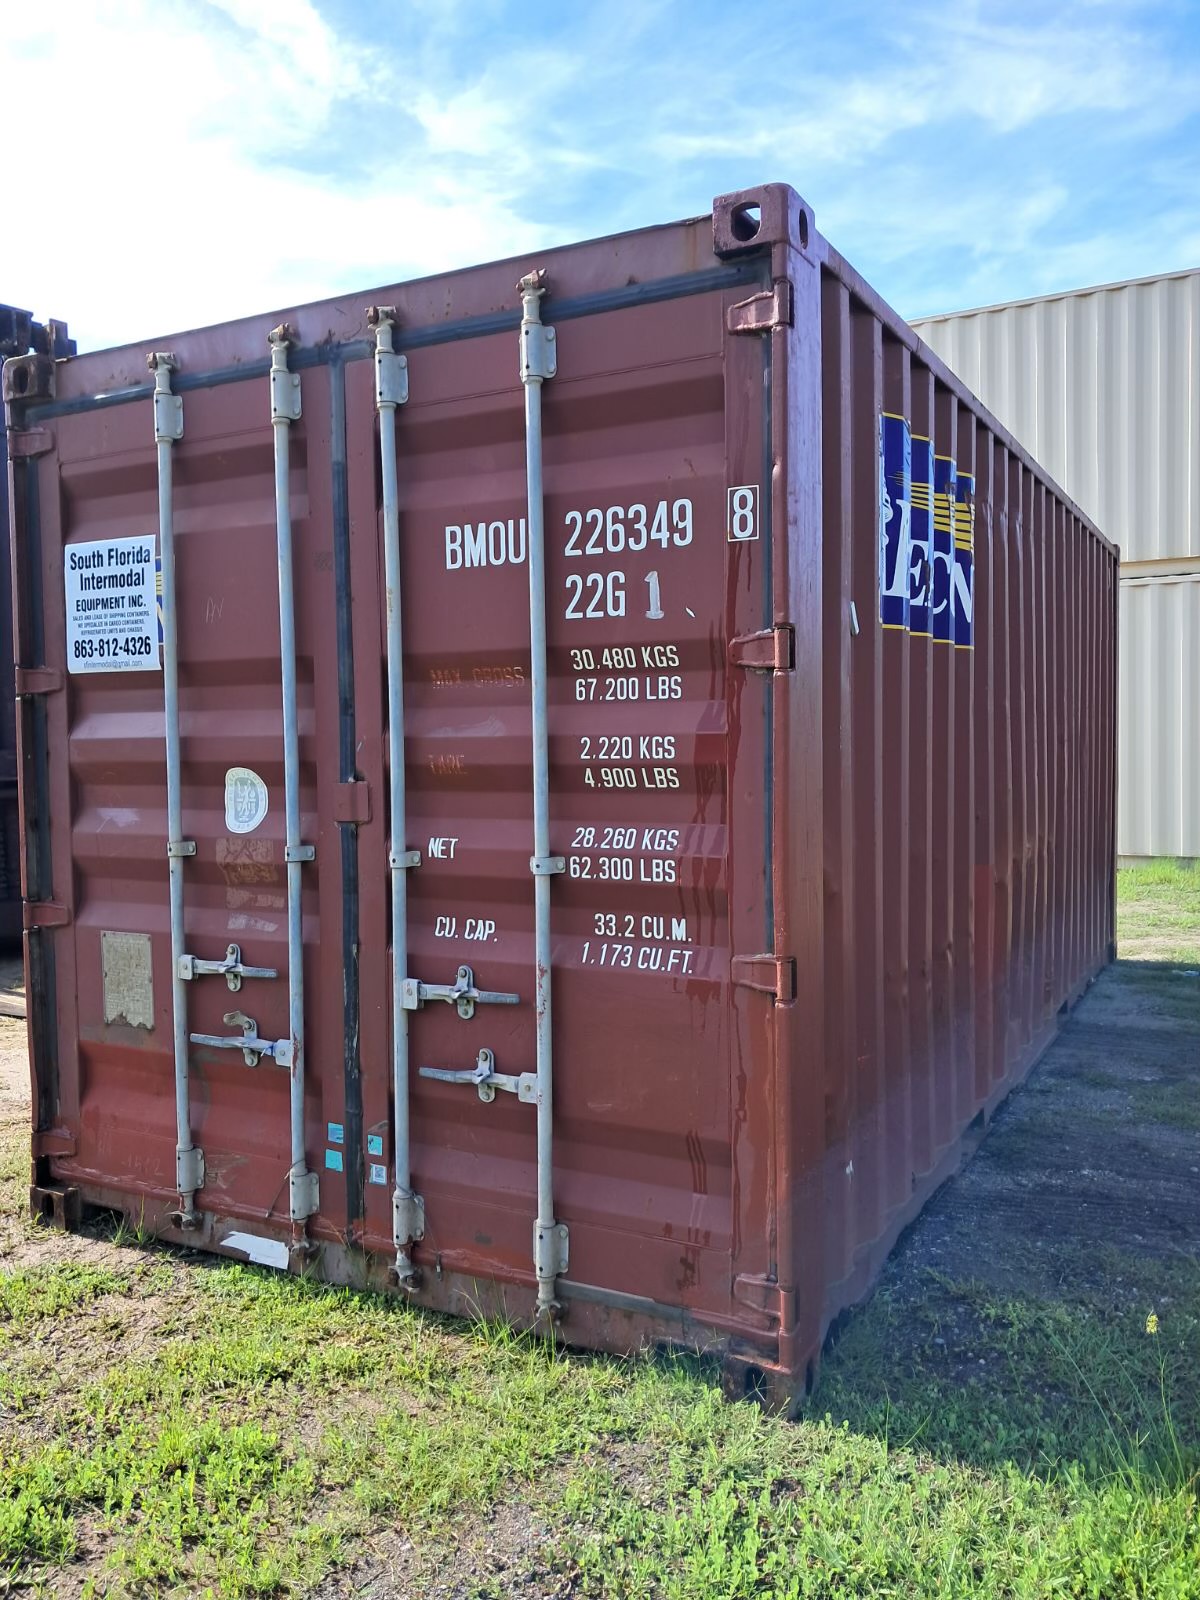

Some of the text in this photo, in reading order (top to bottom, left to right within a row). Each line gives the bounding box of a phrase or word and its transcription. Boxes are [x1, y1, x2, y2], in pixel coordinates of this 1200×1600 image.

[445, 488, 754, 570] BMOU 226349 8
[70, 545, 151, 571] South Florida
[80, 567, 145, 591] Intermodal
[76, 594, 147, 613] EQUIPMENT INC.
[564, 571, 626, 620] 22G
[74, 635, 152, 659] 863-812-4326
[641, 645, 679, 668] KGS
[646, 675, 683, 700] LBS
[639, 736, 676, 760] KGS
[642, 767, 680, 789] LBS
[428, 837, 459, 859] NET
[641, 828, 680, 851] KGS
[640, 859, 676, 883] LBS
[435, 913, 693, 943] CU. CAP. 33.2 CU.M.
[637, 945, 694, 974] CU.FT.
